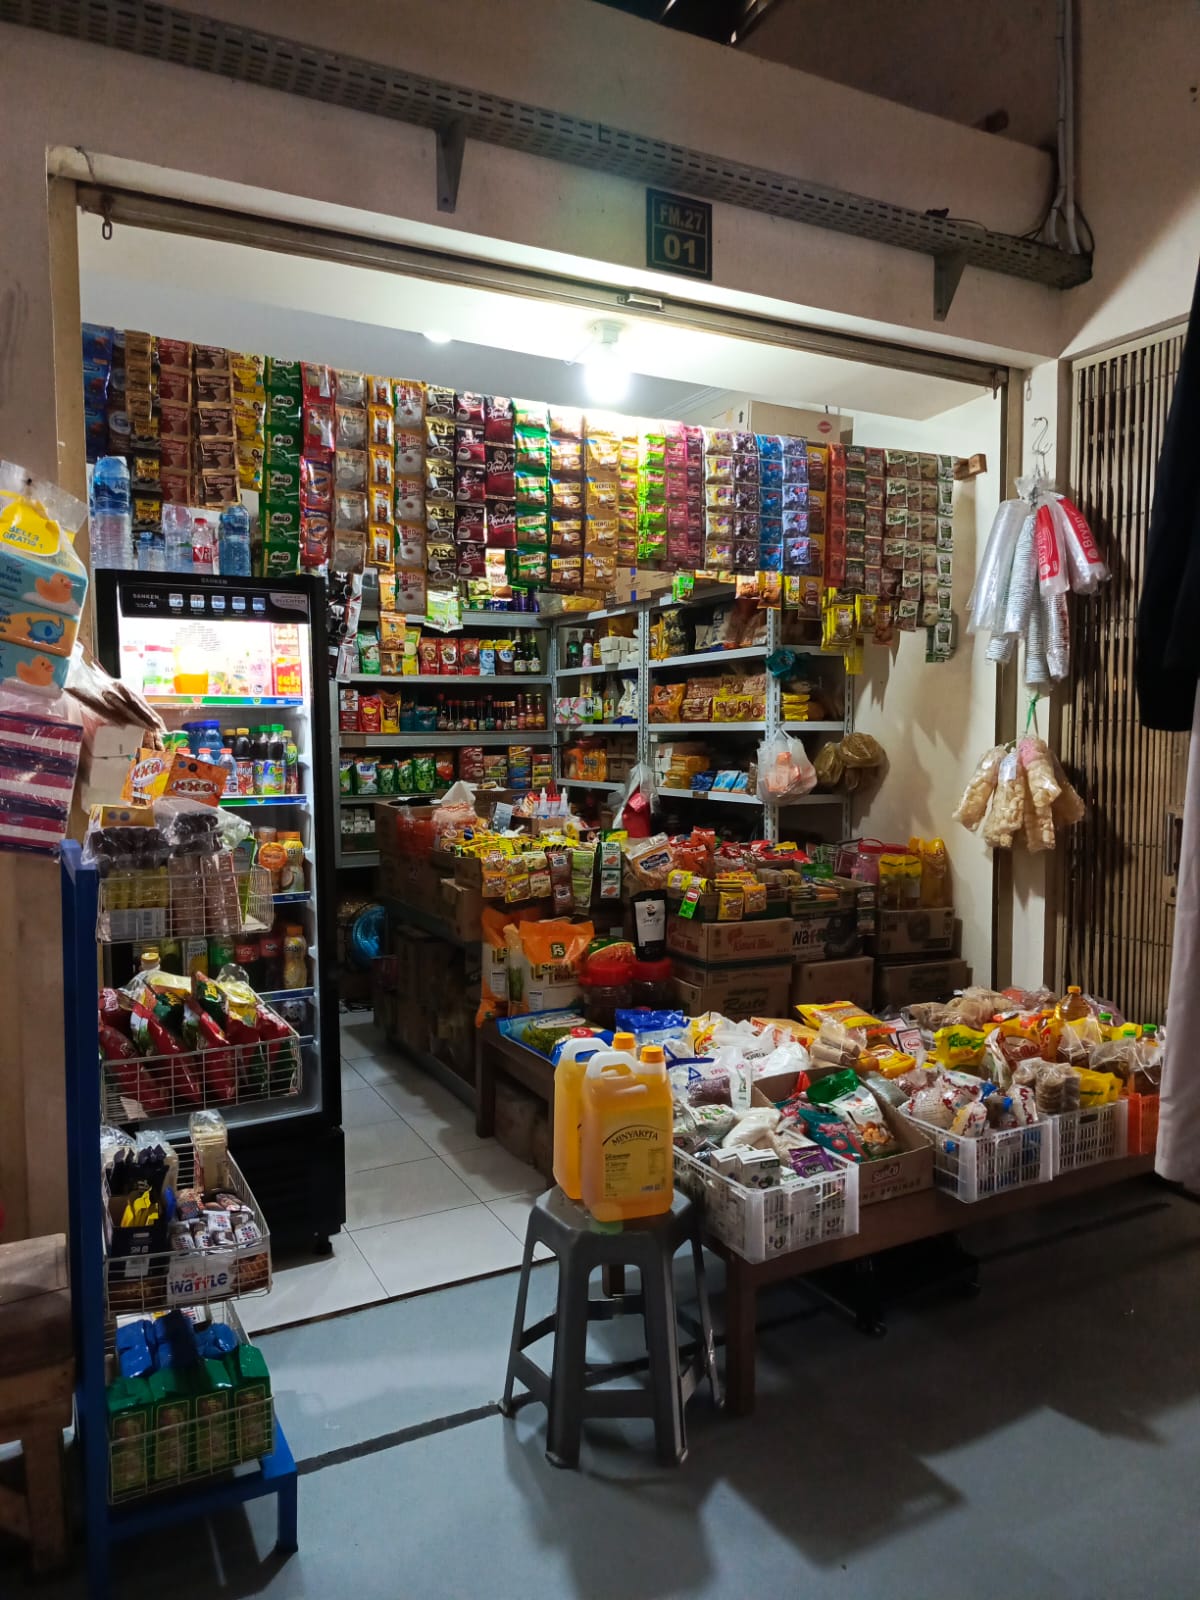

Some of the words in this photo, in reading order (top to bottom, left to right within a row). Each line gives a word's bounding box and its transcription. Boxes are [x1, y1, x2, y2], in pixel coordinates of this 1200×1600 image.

[660, 204, 703, 231] FM.27
[664, 233, 695, 265] 01
[275, 397, 292, 405] MILO
[273, 514, 290, 522] MILO
[1074, 516, 1094, 550] Bryan
[271, 553, 289, 561] MILO
[611, 1130, 659, 1146] MINYAKITA
